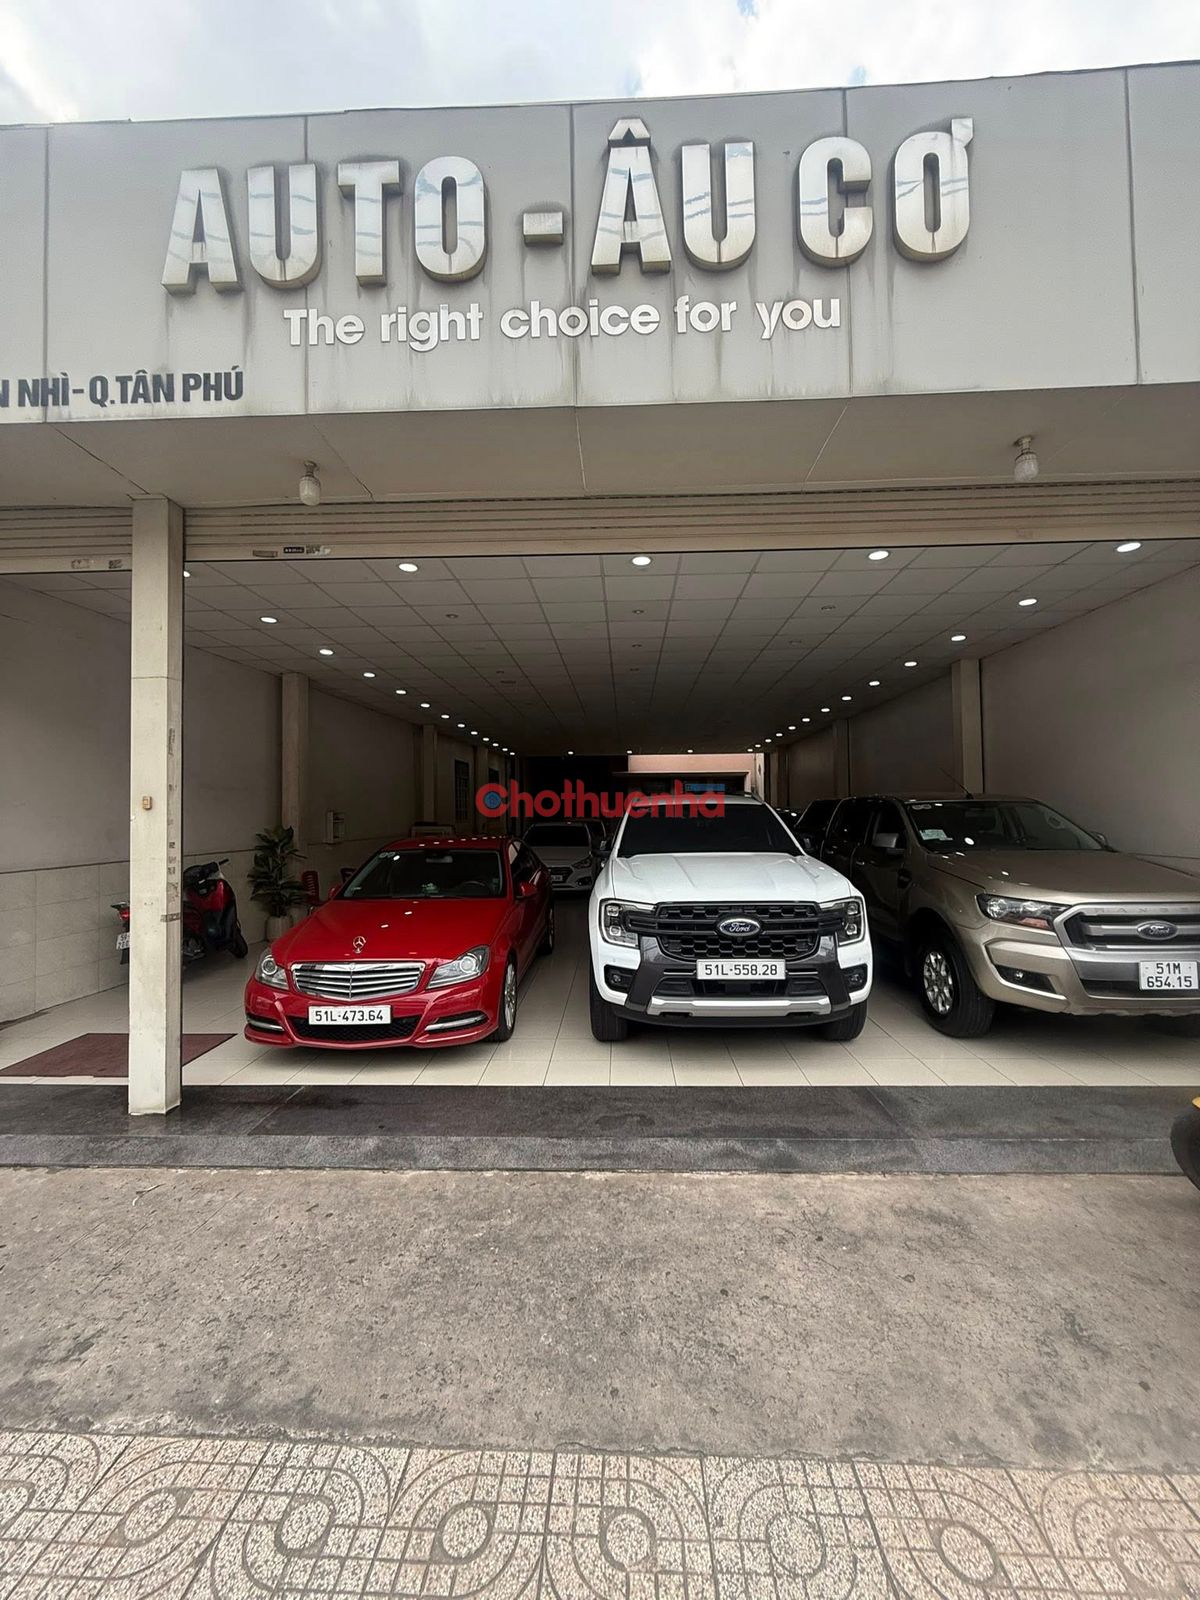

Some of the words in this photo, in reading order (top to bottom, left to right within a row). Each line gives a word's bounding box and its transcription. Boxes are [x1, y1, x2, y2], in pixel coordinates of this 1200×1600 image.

[161, 155, 488, 293] AUTO
[591, 117, 756, 274] ÂU
[798, 116, 973, 267] CƠ
[283, 308, 365, 346] The
[380, 303, 484, 352] right
[500, 299, 660, 339] choice
[673, 294, 737, 334] for
[755, 298, 841, 340] you
[182, 365, 243, 401] PHÚ
[1146, 976, 1192, 988] 654.15
[1155, 962, 1181, 975] 51M
